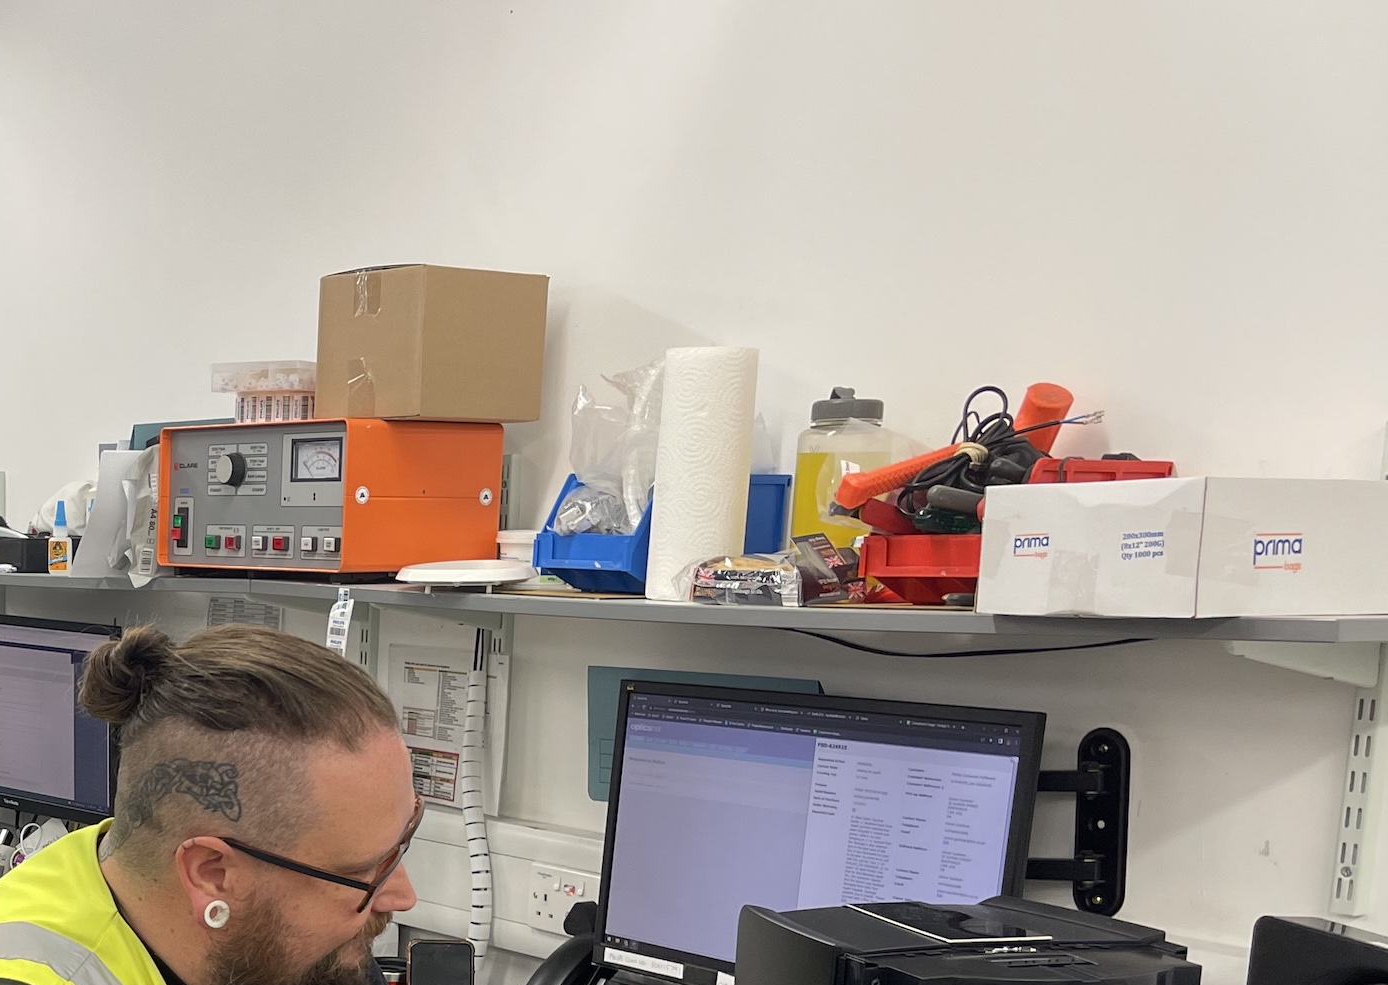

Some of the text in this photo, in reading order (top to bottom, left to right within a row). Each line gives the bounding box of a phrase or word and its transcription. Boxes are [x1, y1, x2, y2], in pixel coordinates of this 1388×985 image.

[1122, 531, 1164, 540] 200x300mm
[1013, 536, 1049, 555] prima
[1253, 538, 1303, 565] prima
[1121, 551, 1164, 560] Qty 1000 pcs
